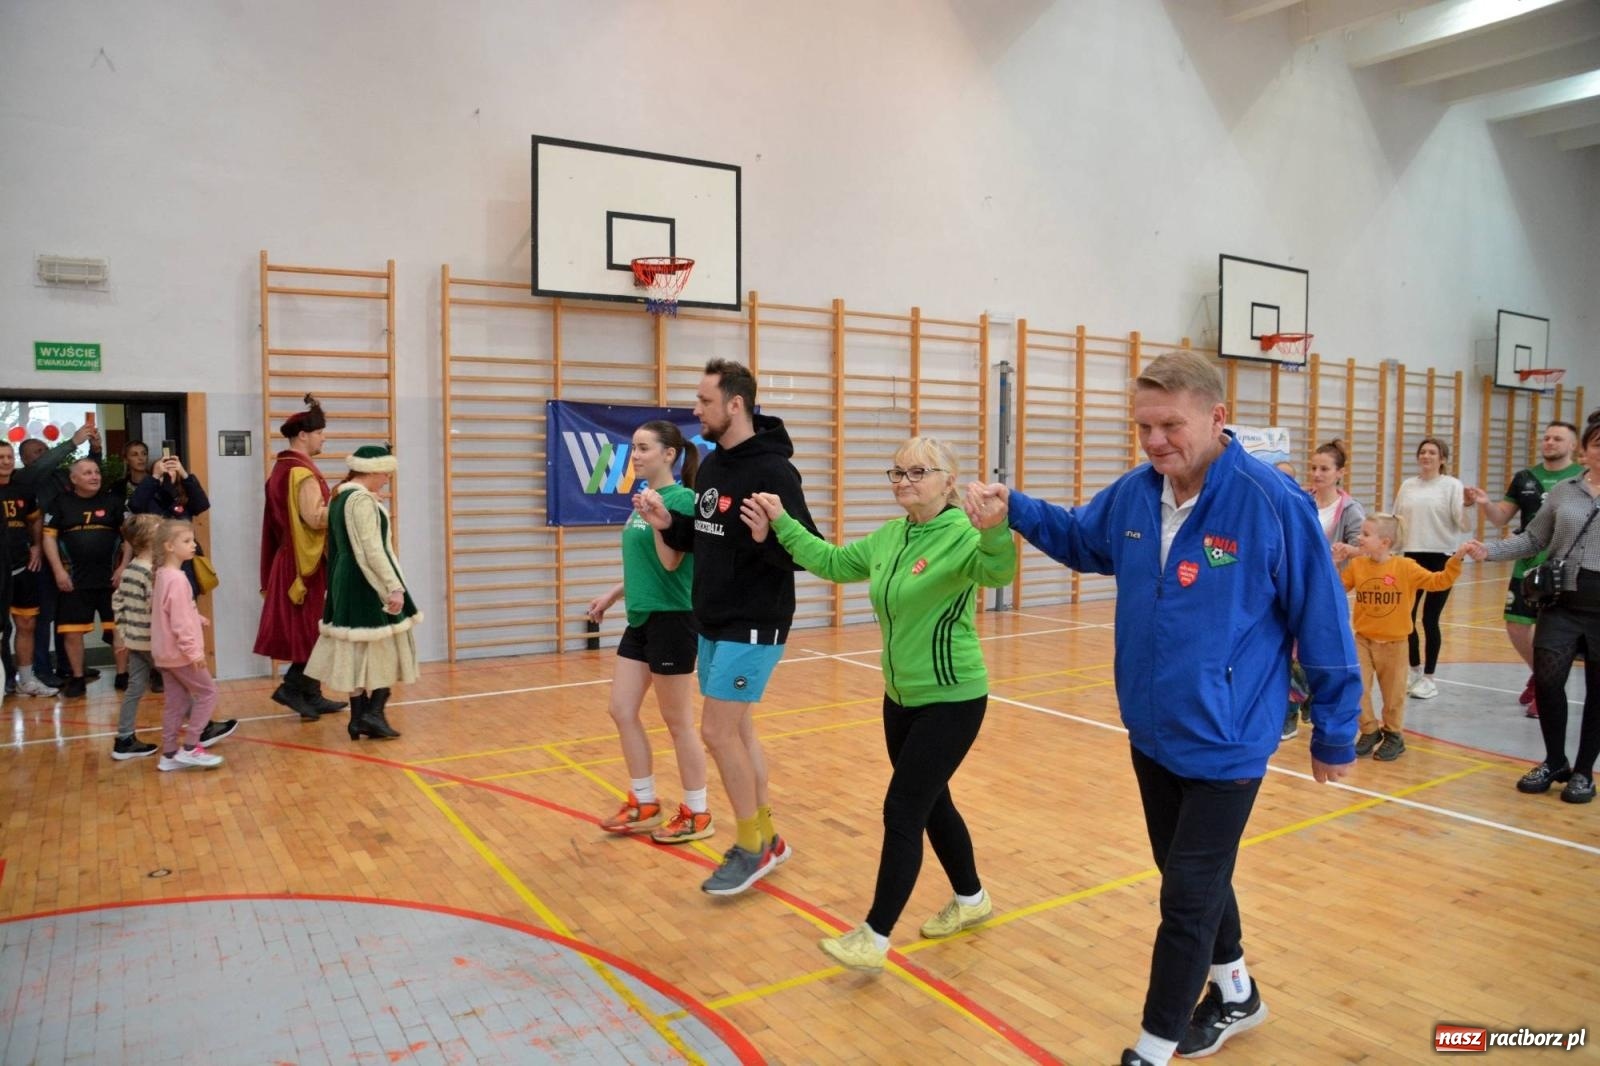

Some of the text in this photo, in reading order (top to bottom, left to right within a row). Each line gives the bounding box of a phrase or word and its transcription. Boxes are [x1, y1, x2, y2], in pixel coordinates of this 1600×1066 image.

[40, 346, 97, 358] WYJŚCIE
[37, 358, 99, 367] EWAKUACYJNE
[2, 499, 17, 518] 13
[83, 511, 92, 524] 7
[1356, 591, 1403, 605] DETROIT
